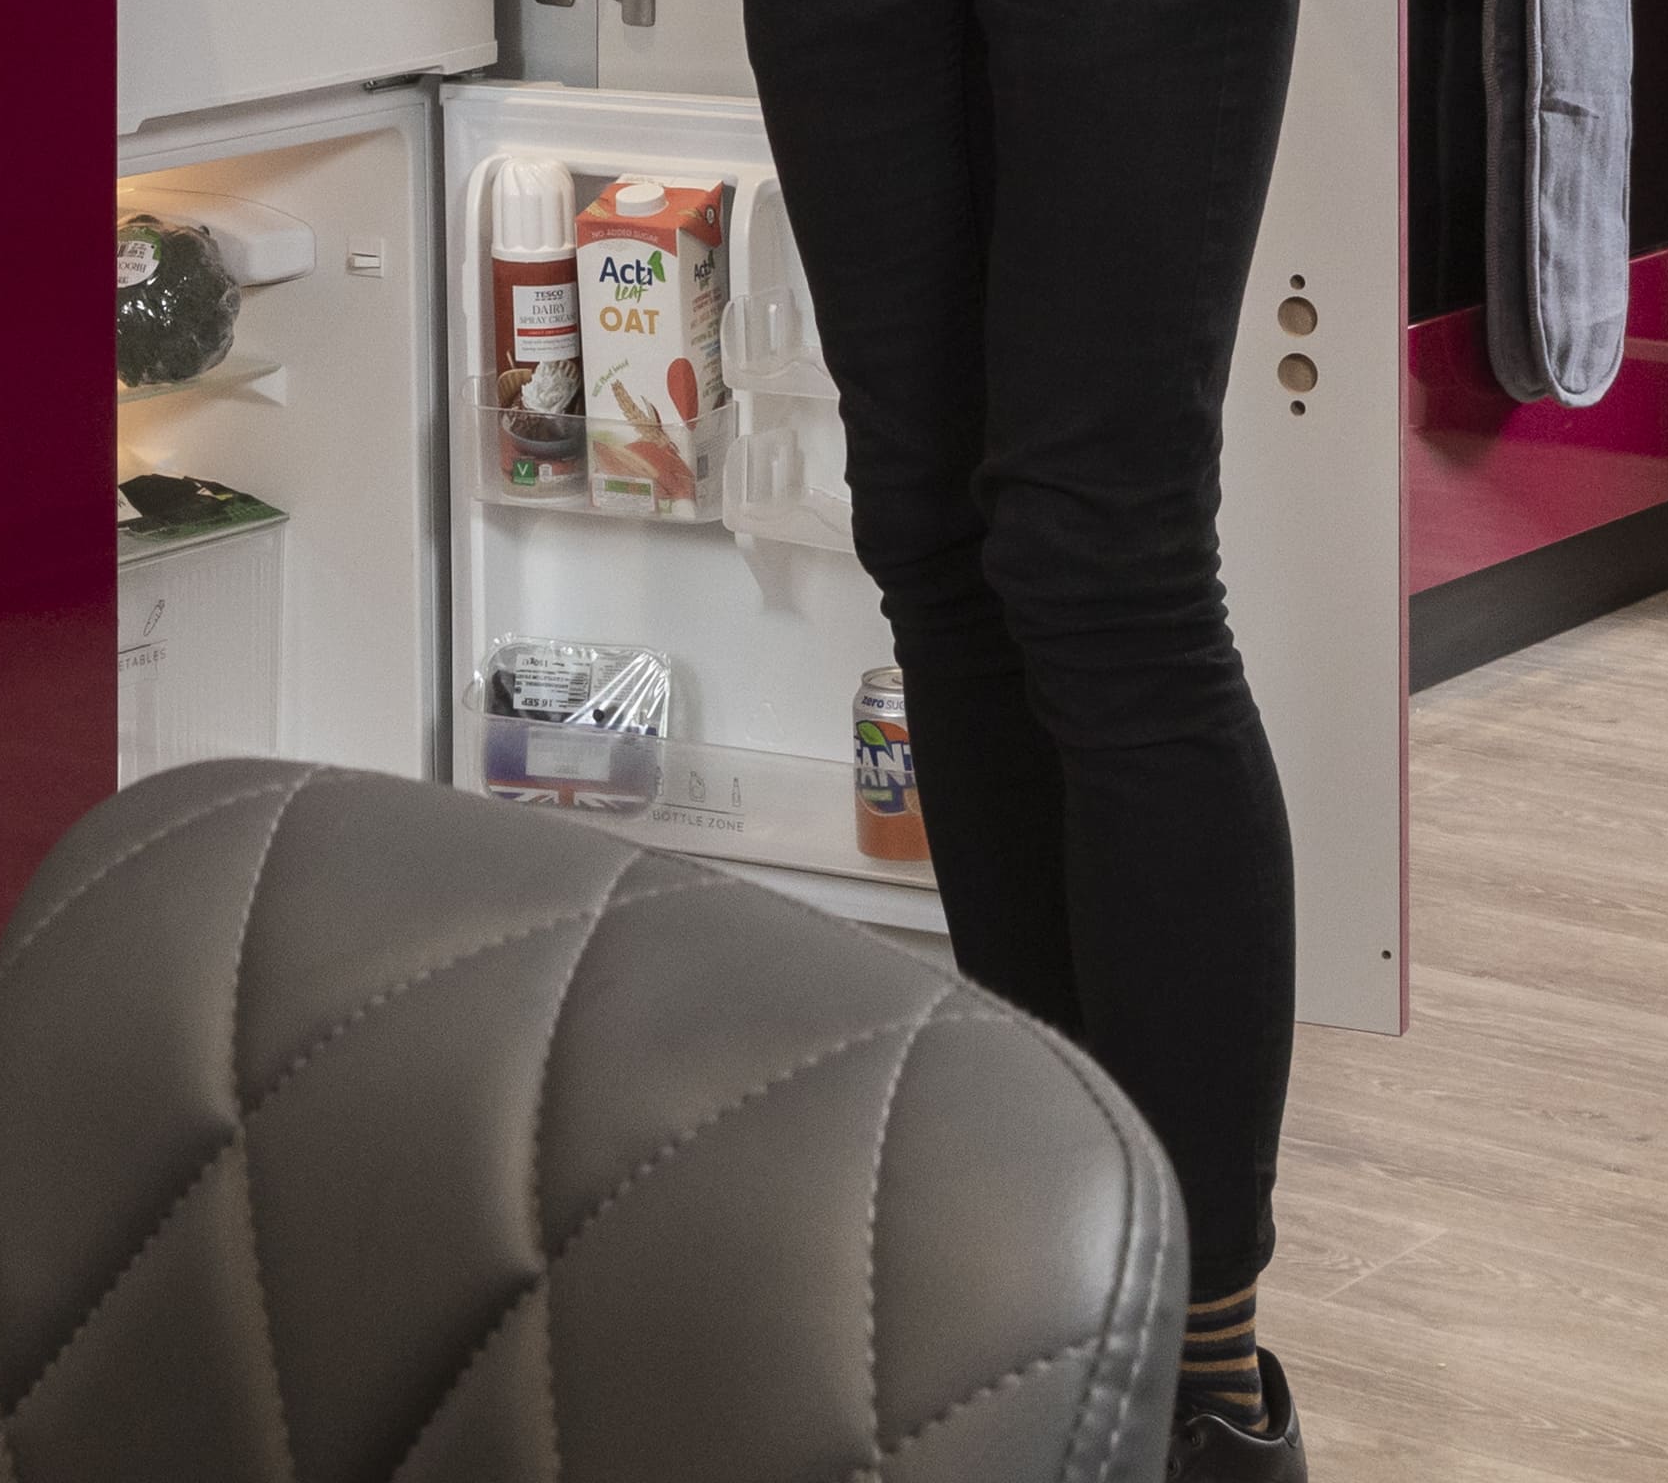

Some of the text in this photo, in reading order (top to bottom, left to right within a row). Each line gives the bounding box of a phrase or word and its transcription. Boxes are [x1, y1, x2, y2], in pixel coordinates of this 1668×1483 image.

[534, 288, 564, 301] TESCO
[532, 303, 566, 315] DAIRY
[599, 306, 660, 335] OAT
[861, 696, 884, 709] zero
[652, 810, 745, 833] BOTTLE ZONE
